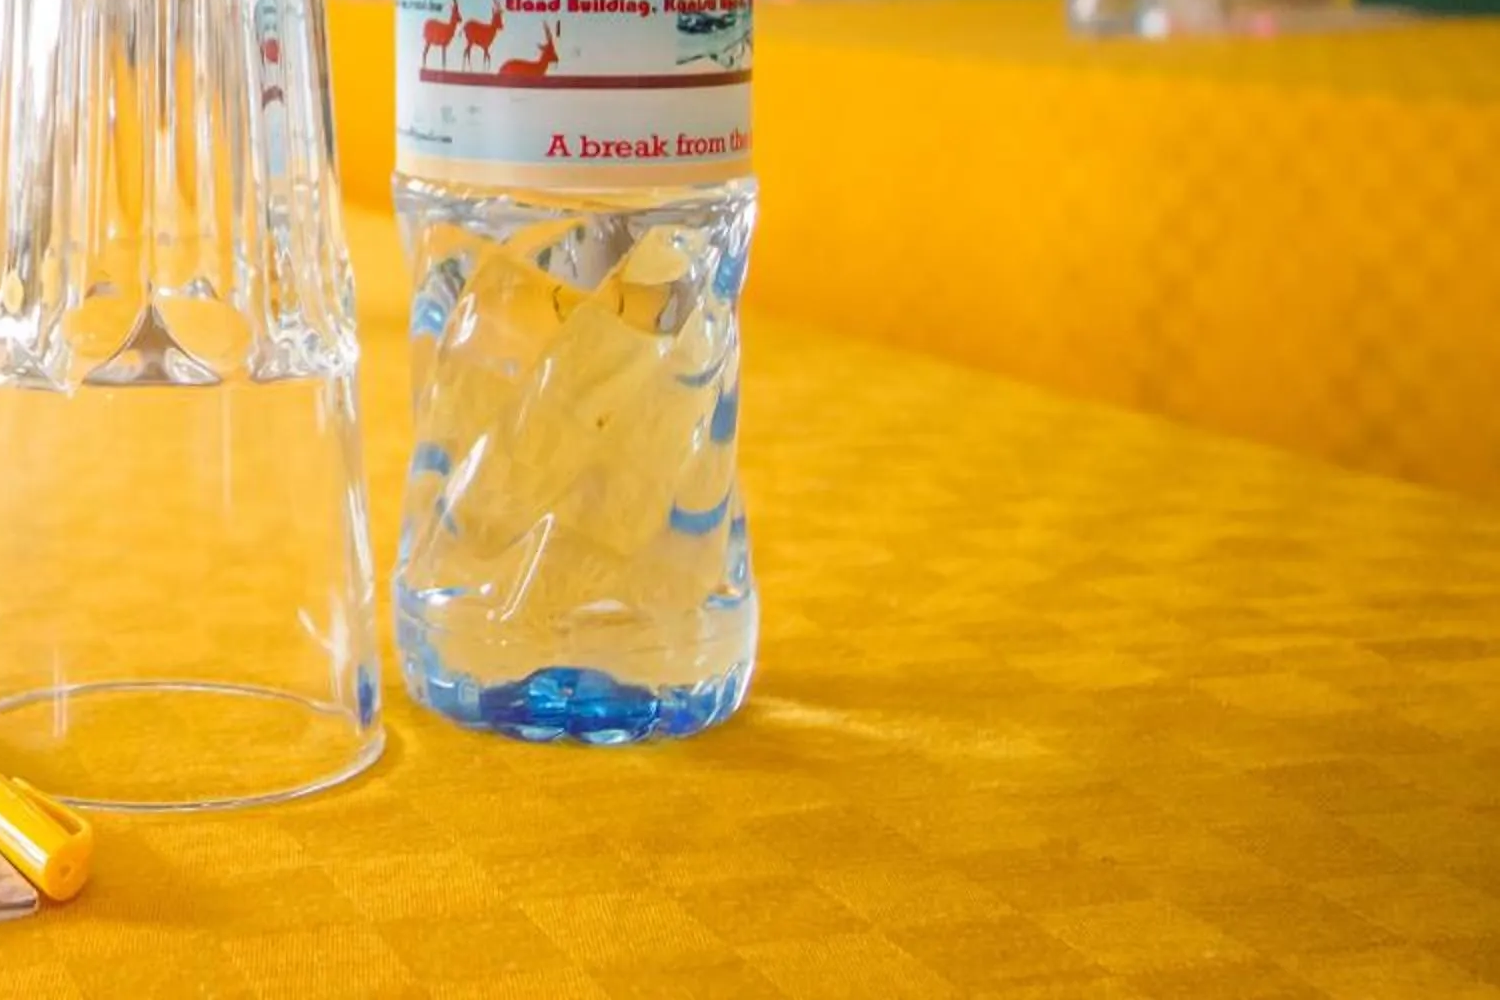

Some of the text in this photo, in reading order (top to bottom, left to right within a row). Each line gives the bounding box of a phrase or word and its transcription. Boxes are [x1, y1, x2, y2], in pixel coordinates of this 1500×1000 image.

[546, 134, 571, 157] A
[579, 134, 670, 158] break
[675, 133, 726, 156] from
